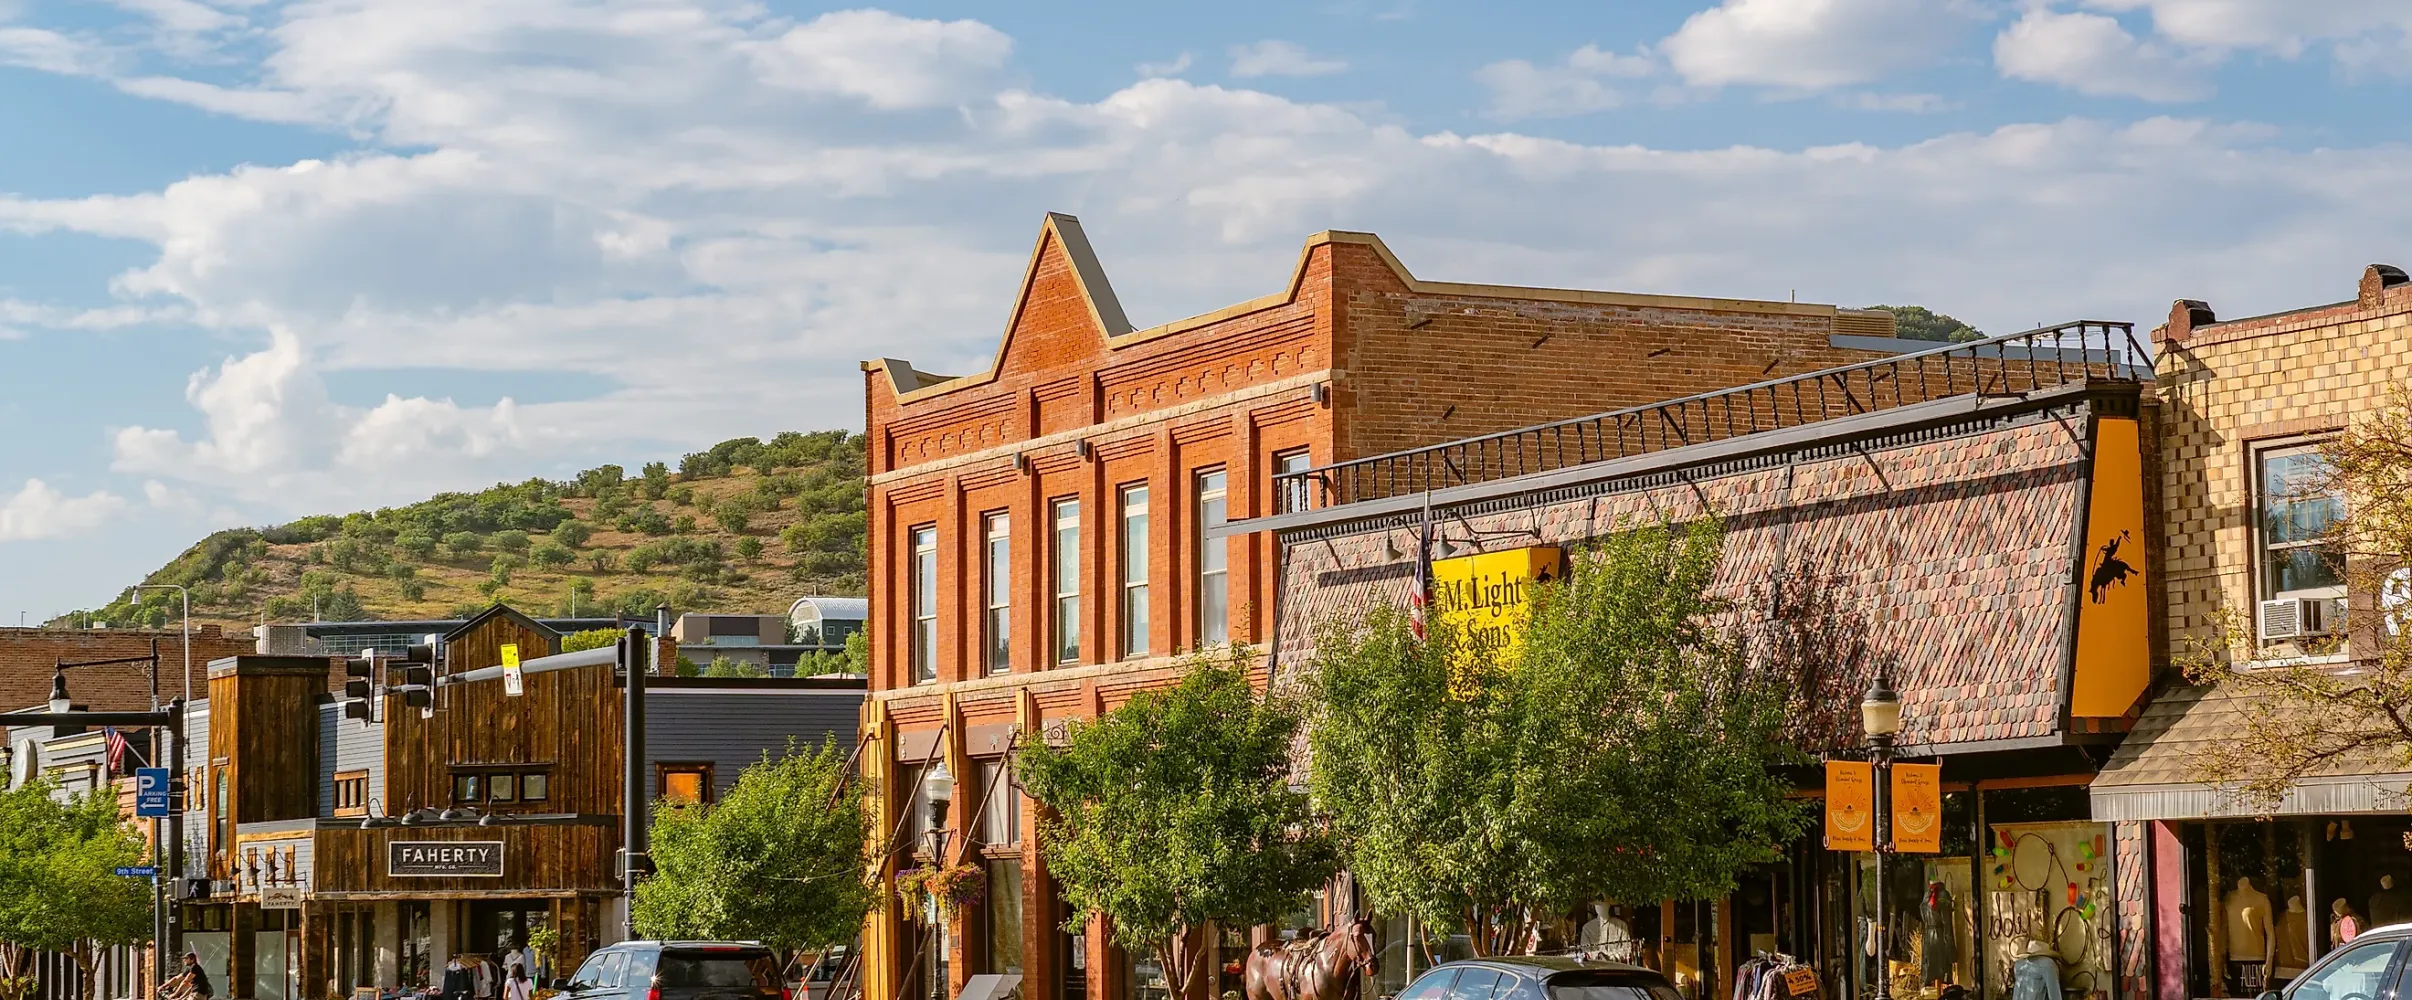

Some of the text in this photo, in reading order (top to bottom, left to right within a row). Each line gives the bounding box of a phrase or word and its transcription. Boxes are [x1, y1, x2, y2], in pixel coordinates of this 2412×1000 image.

[1471, 570, 1522, 618] Light
[1466, 618, 1511, 652] Sons
[402, 849, 489, 862] FAHERTY
[116, 867, 154, 876] 9th Street
